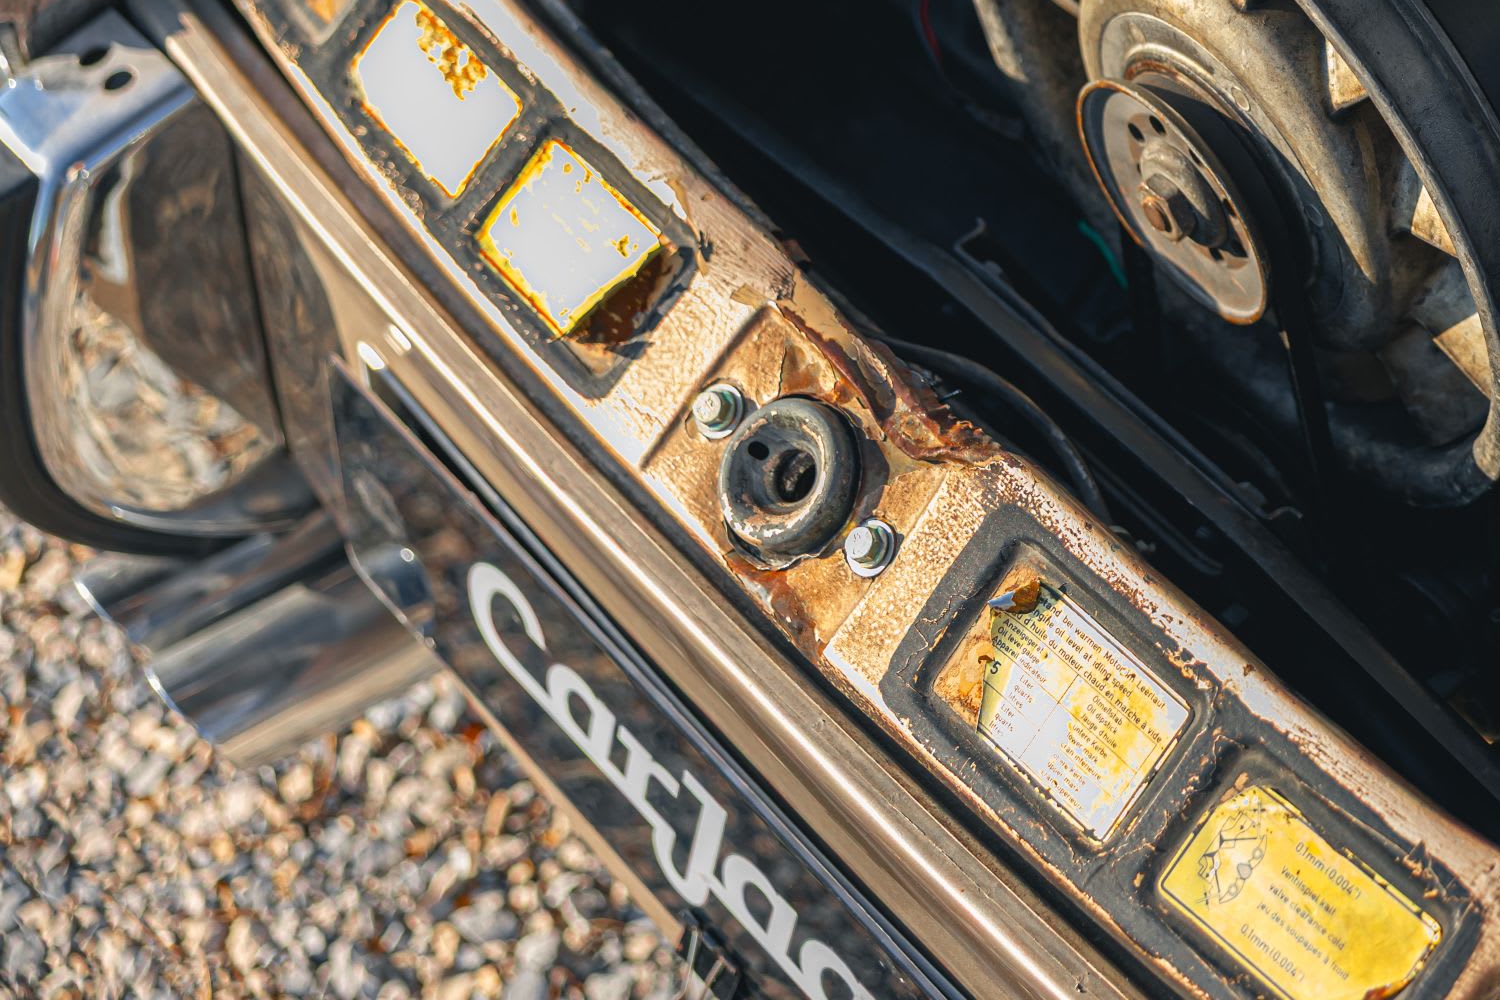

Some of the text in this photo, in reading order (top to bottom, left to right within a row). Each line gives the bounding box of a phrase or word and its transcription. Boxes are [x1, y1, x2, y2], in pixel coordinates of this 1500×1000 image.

[992, 635, 1018, 659] Appareil
[997, 626, 1039, 665] Oil level gauge
[1031, 607, 1055, 629] ngine
[1055, 626, 1065, 636] oil
[1066, 636, 1082, 652] level
[1083, 652, 1092, 660] at
[1091, 660, 1112, 680] idling
[1110, 677, 1132, 698] speed
[1062, 616, 1074, 627] bei
[1074, 628, 1101, 652] warmen
[1103, 652, 1125, 672] Motor
[1023, 616, 1048, 640] d'huile
[1048, 639, 1058, 648] du
[1058, 648, 1082, 670] moteur
[1083, 670, 1105, 690] chaud
[1105, 690, 1114, 699] en
[1115, 698, 1141, 722] marche
[1147, 727, 1162, 742] vide
[1080, 713, 1098, 730] Jauge
[1086, 704, 1117, 734] Oil dipstick
[1066, 733, 1098, 762] lower mark
[1090, 740, 1108, 757] Kerbe
[1278, 866, 1336, 915] Ventilspiel kalt
[1268, 883, 1345, 949] valve clearance cold
[1270, 911, 1286, 925] des
[1284, 925, 1322, 958] soupapes
[1329, 962, 1349, 979] froid
